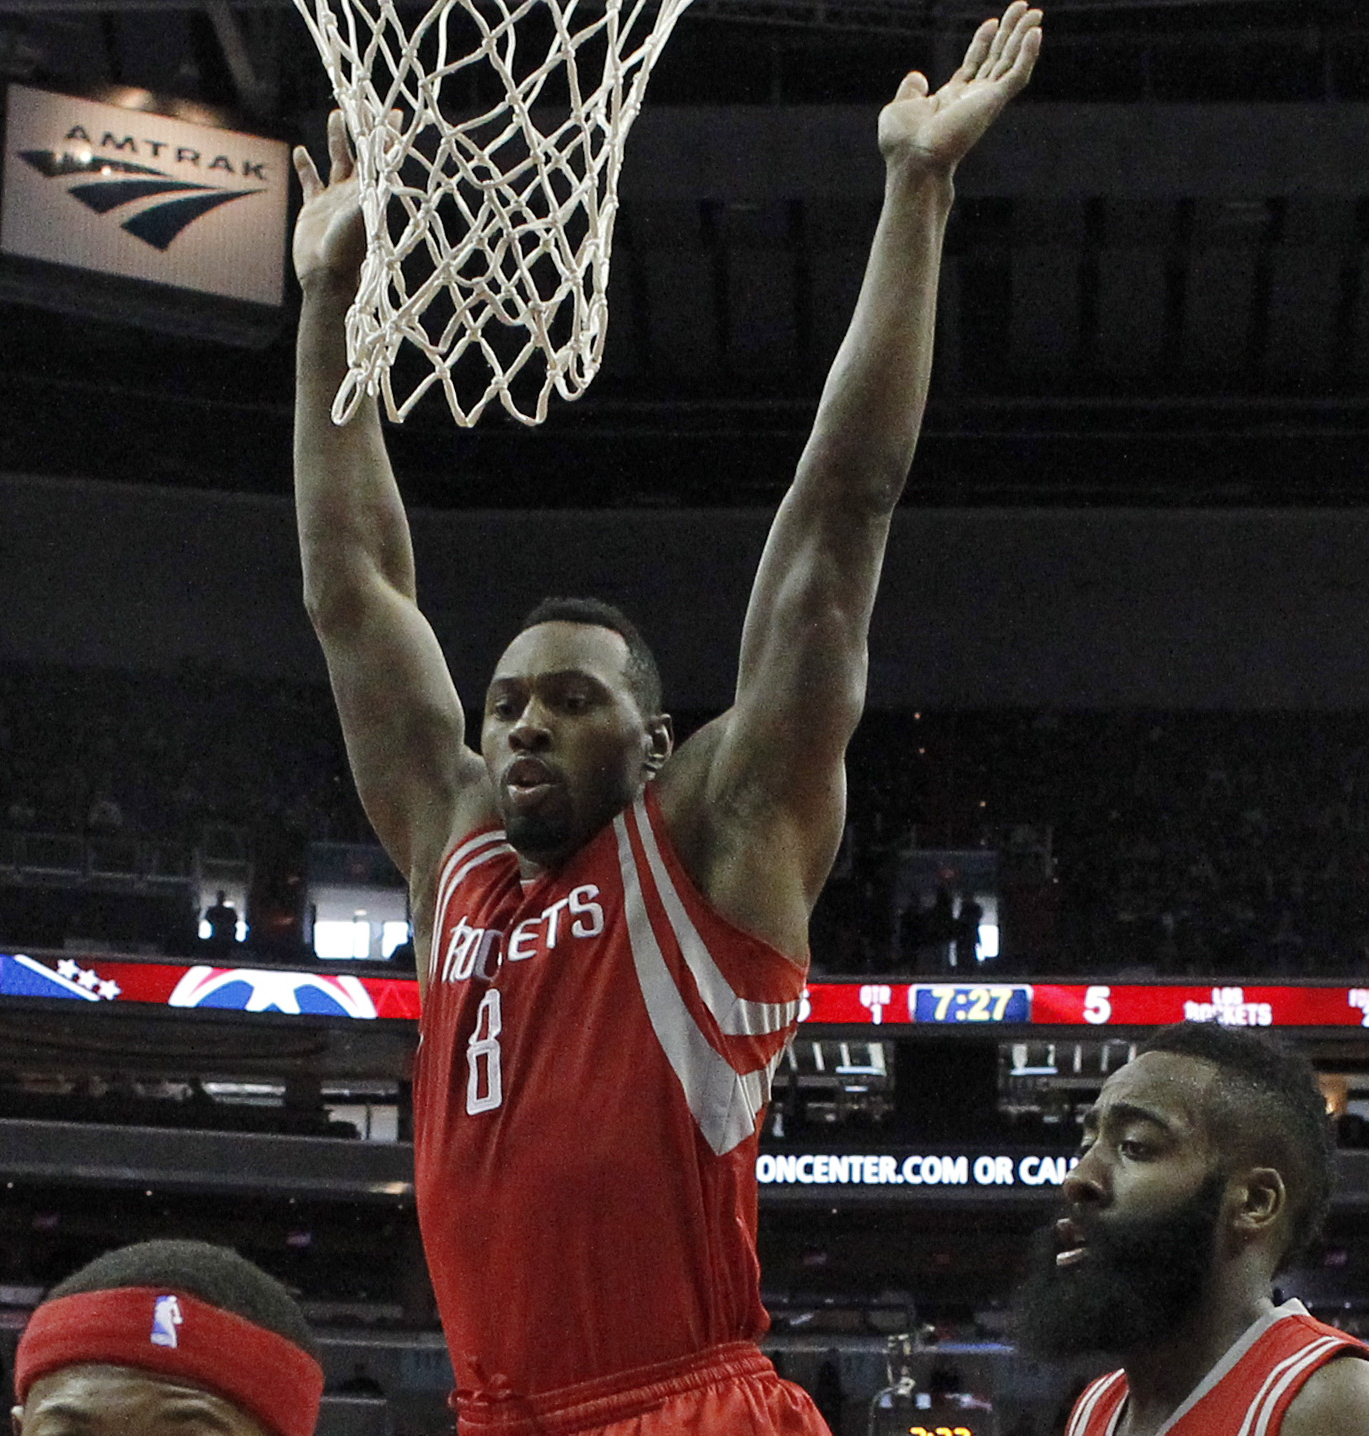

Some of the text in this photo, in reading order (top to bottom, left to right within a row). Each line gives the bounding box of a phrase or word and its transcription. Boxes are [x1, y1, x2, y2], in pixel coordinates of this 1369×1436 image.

[65, 125, 267, 180] AMTRAK
[442, 884, 605, 983] ROCETS
[932, 987, 1013, 1021] 7:27
[1083, 985, 1112, 1025] 5
[466, 988, 502, 1116] 8
[755, 1155, 969, 1185] ONCENTER.COM
[973, 1156, 1015, 1185] OR
